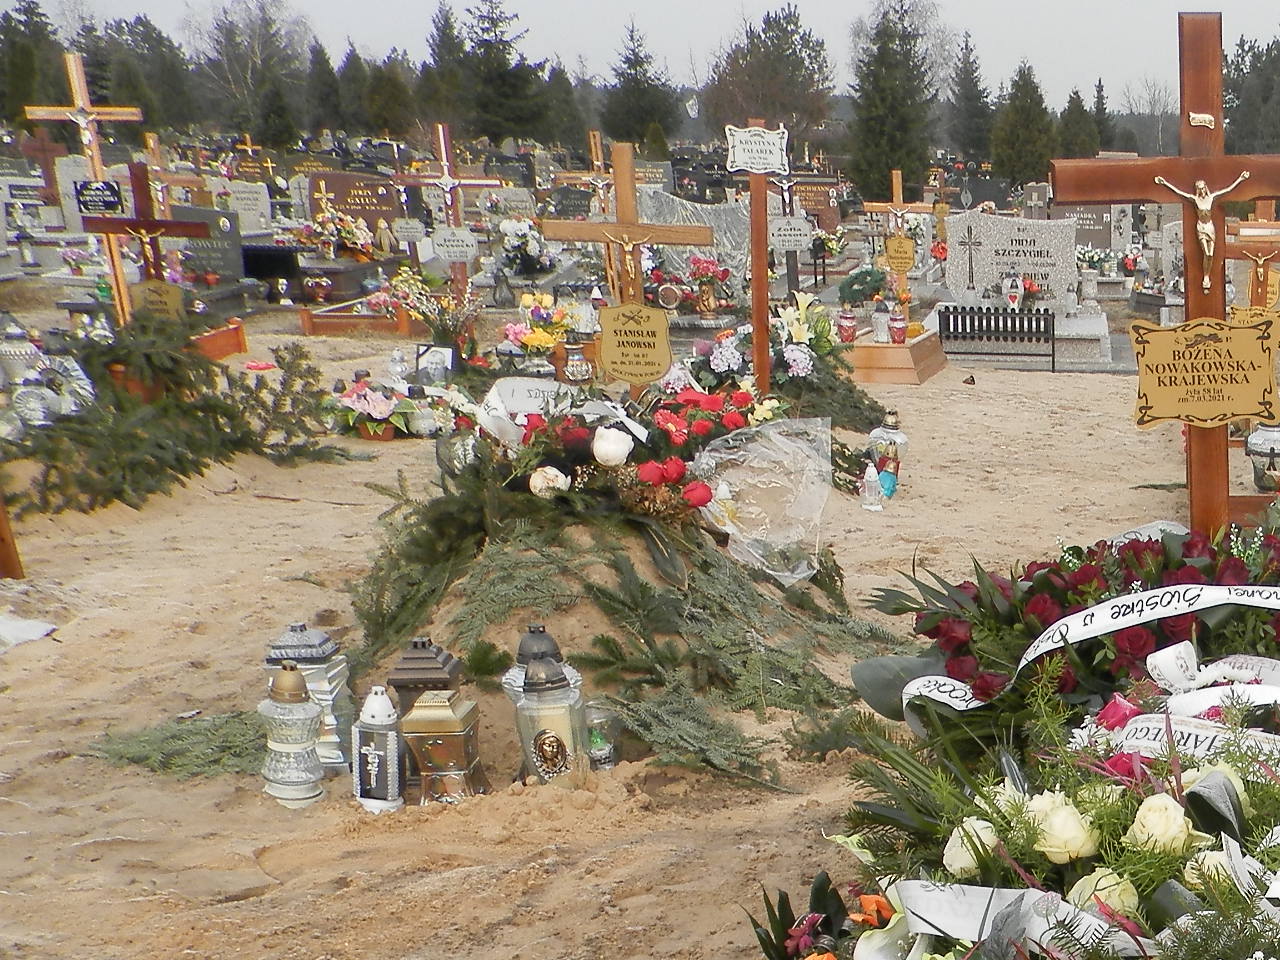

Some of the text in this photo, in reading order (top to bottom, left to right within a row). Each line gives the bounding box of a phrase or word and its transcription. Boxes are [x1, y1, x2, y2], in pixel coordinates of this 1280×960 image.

[613, 329, 657, 338] STANISŁAW
[616, 340, 656, 349] JANOWSKI
[1172, 346, 1233, 361] BOŻENA
[1144, 359, 1262, 375] NOWAKOWSKA-
[1157, 373, 1250, 387] KRAJEWSKA
